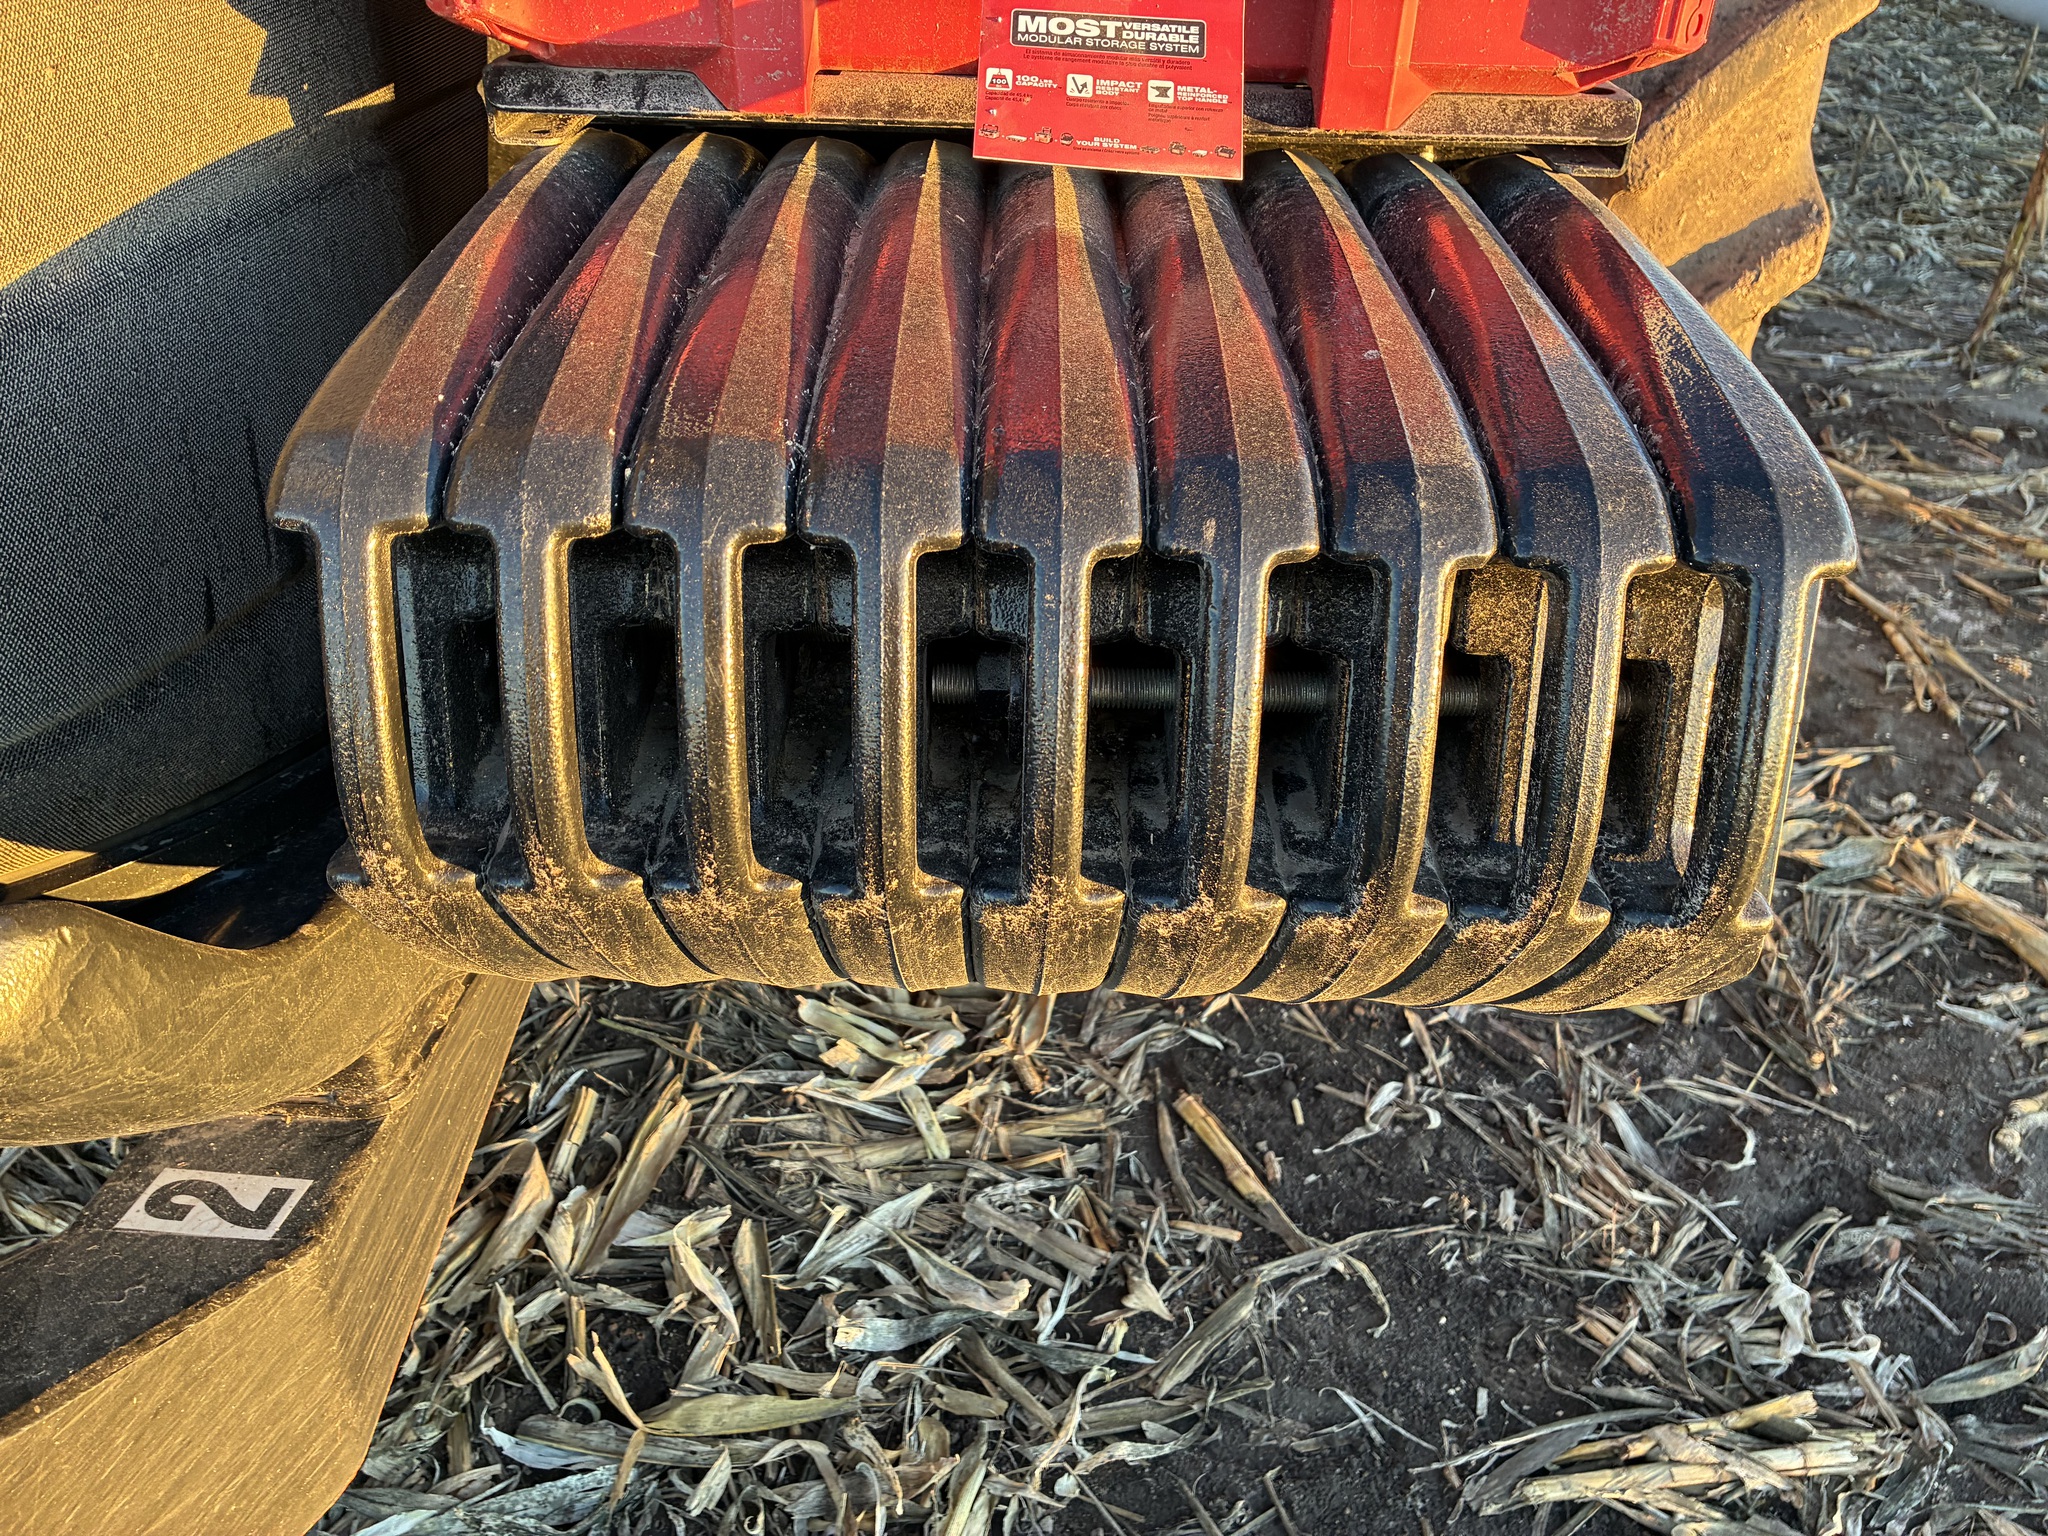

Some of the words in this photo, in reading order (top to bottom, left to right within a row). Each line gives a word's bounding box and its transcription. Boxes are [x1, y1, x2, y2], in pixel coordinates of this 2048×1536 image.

[1018, 15, 1122, 38] MOST
[1123, 22, 1200, 34] VERSATILE
[1122, 30, 1200, 44] DURABLE
[1018, 34, 1082, 46] MODULAR
[1086, 38, 1146, 50] STORAGE
[1150, 43, 1200, 54] SYSTEM
[1016, 80, 1058, 88] CAPACITY
[1096, 79, 1142, 88] IMPACT
[1177, 86, 1218, 94] METAL-
[1177, 92, 1228, 100] REINFORCED
[144, 1179, 296, 1230] 2
